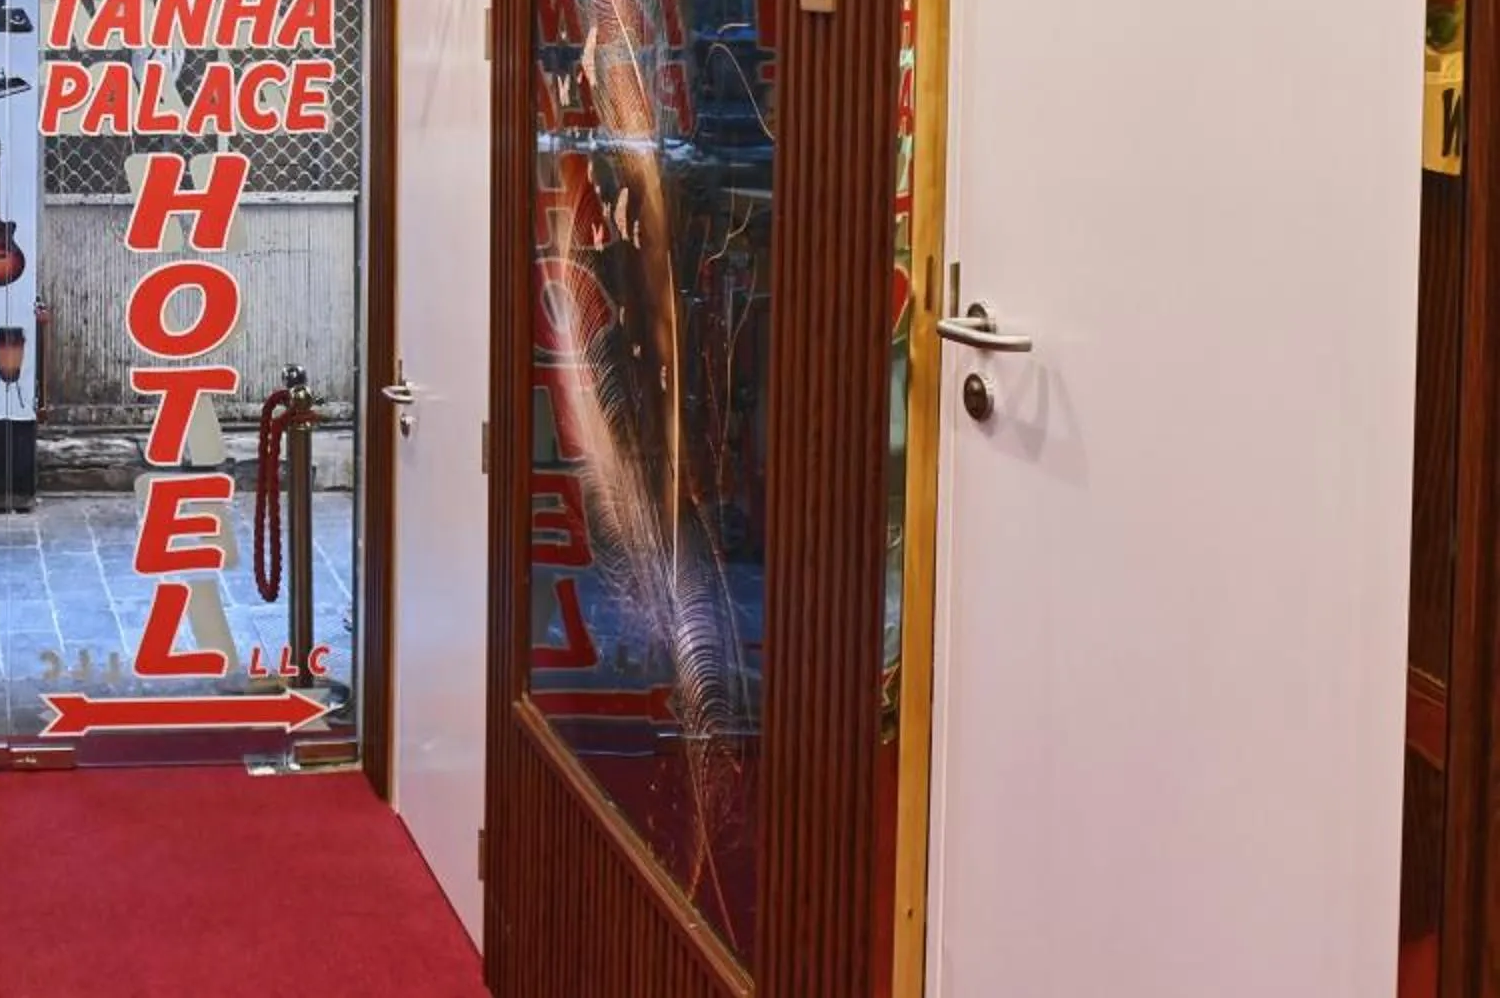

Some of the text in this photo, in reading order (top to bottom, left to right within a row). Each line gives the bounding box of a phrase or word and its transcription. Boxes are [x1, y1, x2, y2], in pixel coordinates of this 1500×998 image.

[40, 59, 335, 134] PALACE
[125, 152, 251, 678] HOTEL
[249, 645, 331, 677] LLC
